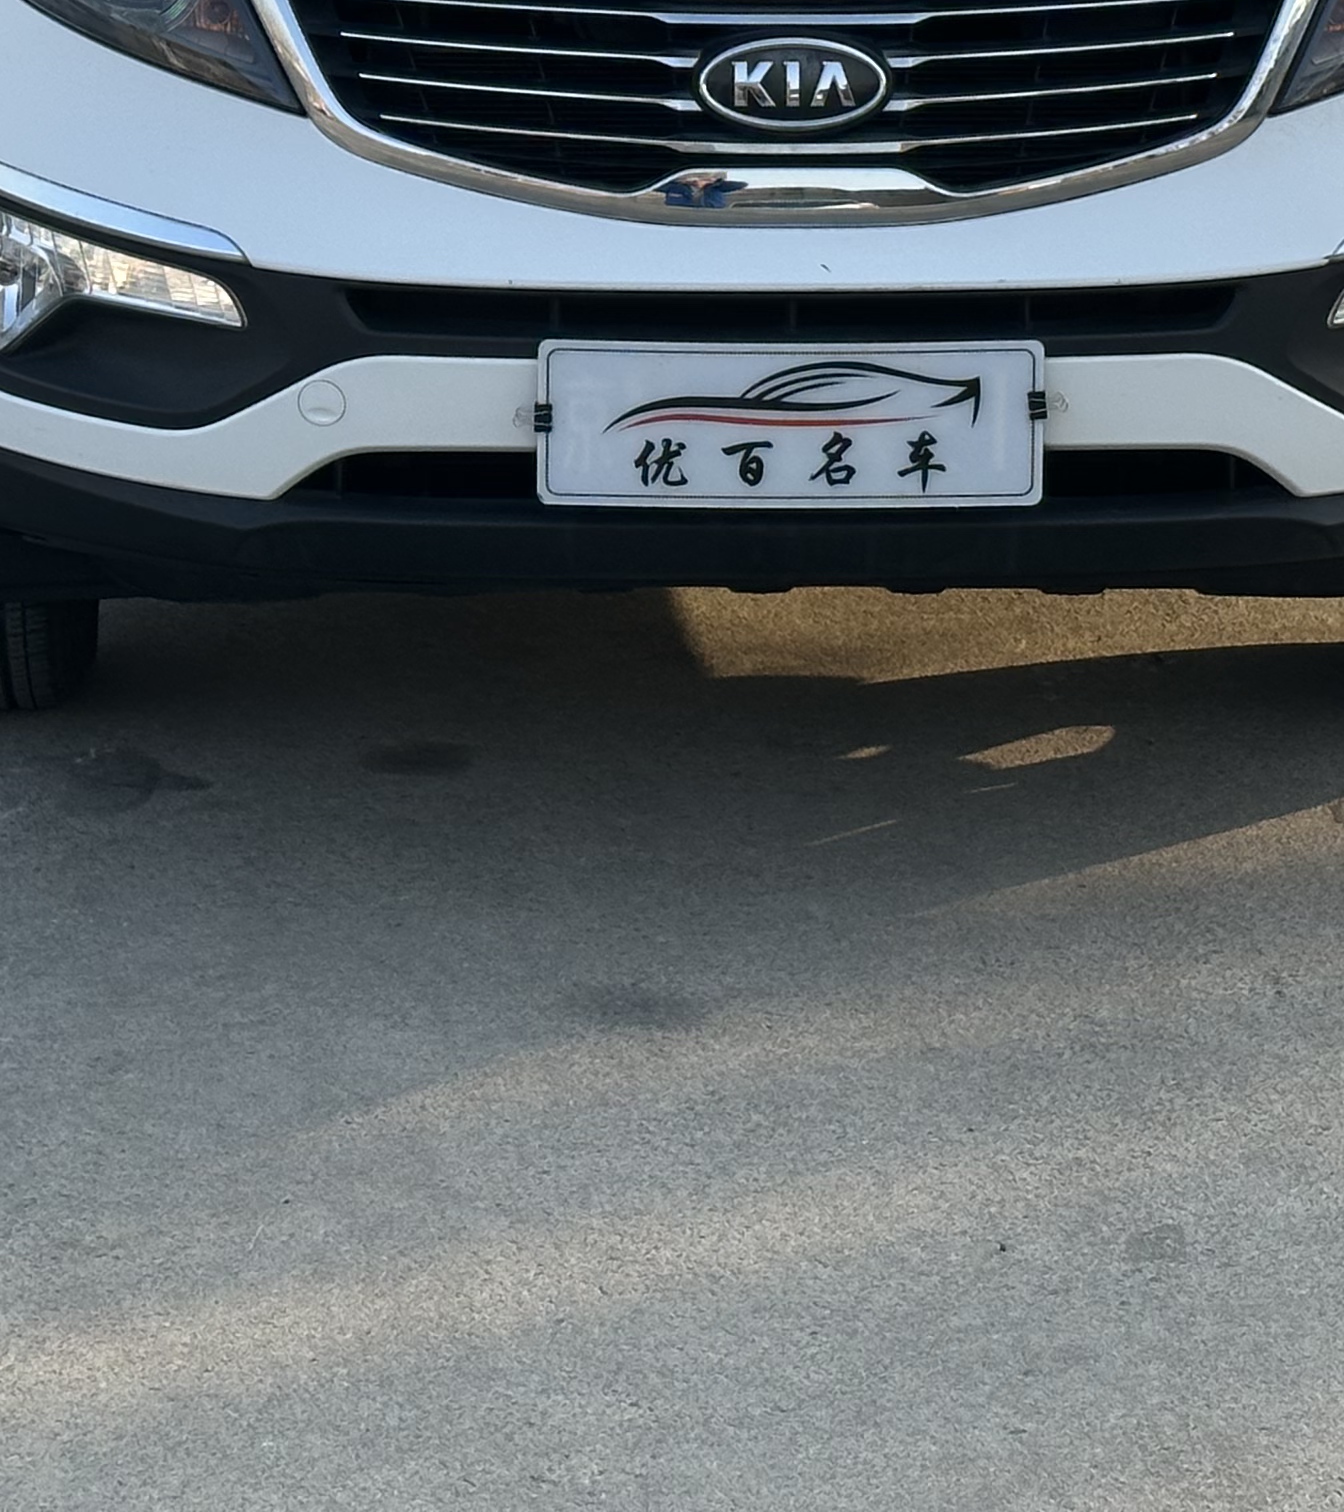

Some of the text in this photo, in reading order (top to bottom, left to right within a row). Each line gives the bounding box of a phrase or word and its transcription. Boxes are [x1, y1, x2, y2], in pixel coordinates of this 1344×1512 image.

[731, 60, 856, 107] KIA
[633, 431, 947, 494] 优百名车
